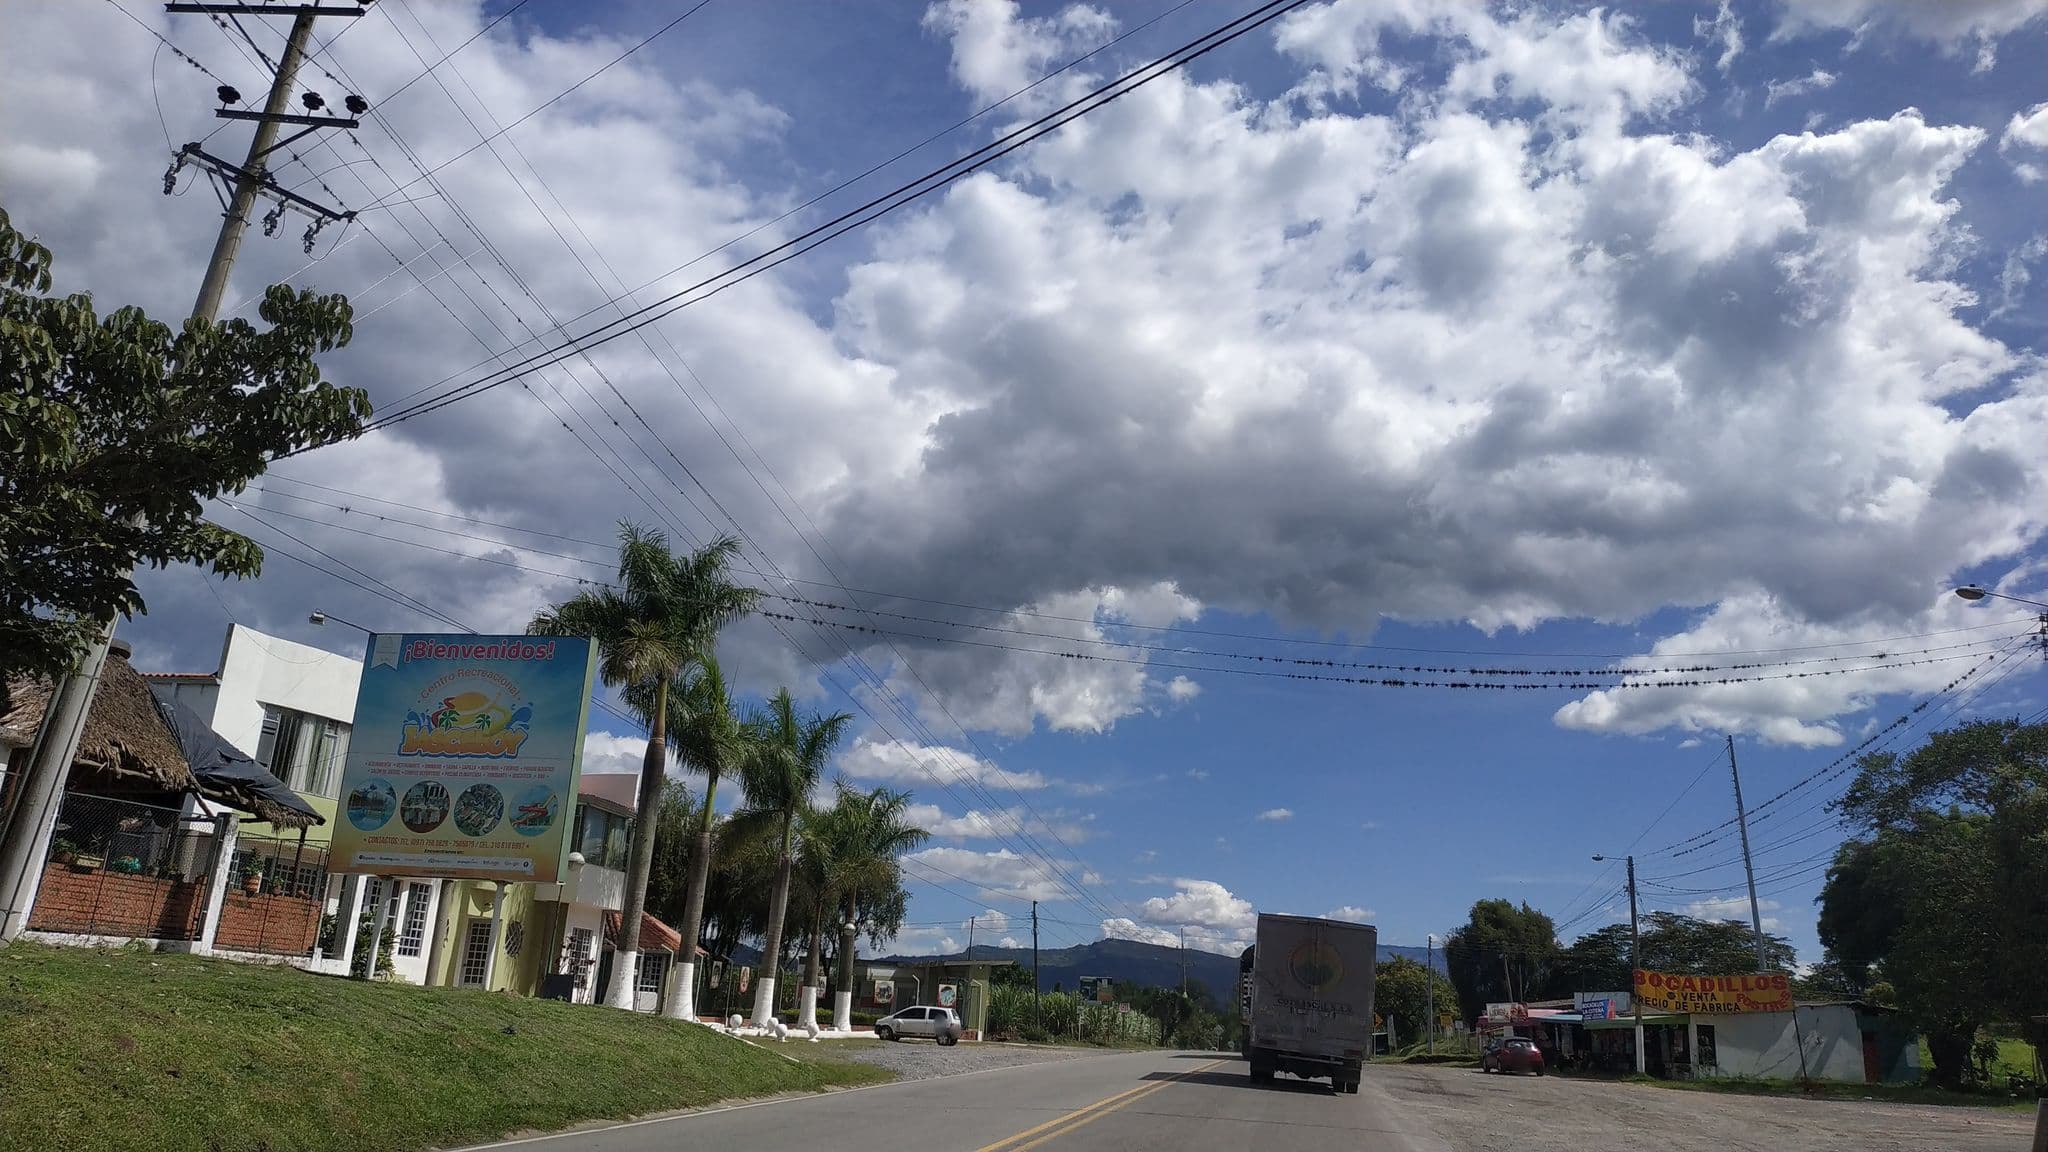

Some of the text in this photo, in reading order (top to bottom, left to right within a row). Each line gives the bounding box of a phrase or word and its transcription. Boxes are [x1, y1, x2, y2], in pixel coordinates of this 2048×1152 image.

[404, 639, 556, 664] ¡Bienvenidos!
[420, 668, 522, 700] Centro Recreacional
[1633, 970, 1787, 993] BOCADILLOS
[1675, 1001, 1689, 1011] DE
[1694, 1002, 1741, 1013] FABRICA
[1681, 992, 1717, 1002] VENTA
